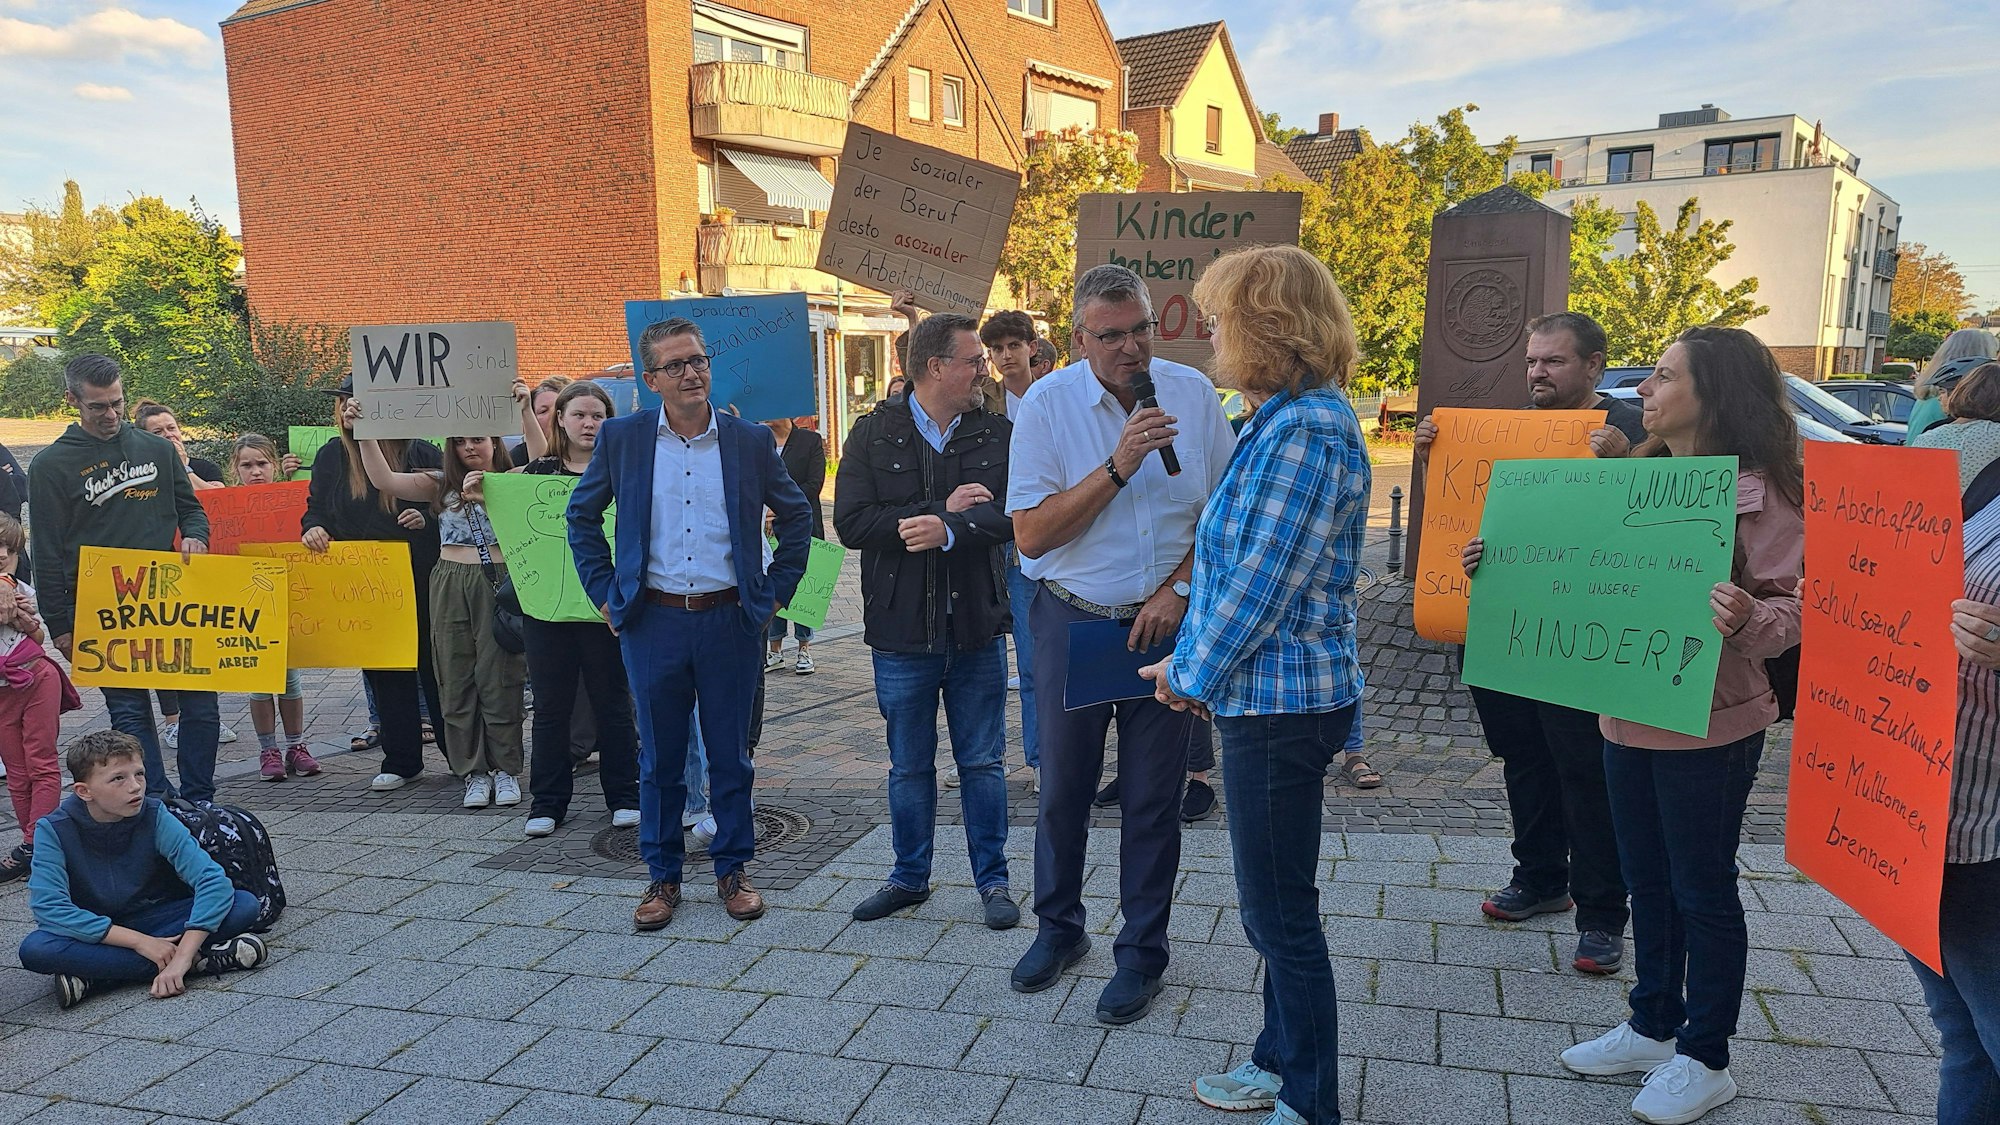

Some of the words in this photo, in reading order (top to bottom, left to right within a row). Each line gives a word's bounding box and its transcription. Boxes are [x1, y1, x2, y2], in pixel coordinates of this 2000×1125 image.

[856, 131, 882, 161] Je
[910, 157, 984, 191] sozialer
[854, 175, 881, 200] der
[900, 187, 966, 225] Beruf
[1116, 200, 1256, 240] Kinder
[838, 208, 880, 239] desto
[894, 233, 969, 264] asozialer
[824, 243, 844, 269] die
[691, 301, 757, 319] brauchen
[363, 332, 451, 387] WIR
[466, 346, 511, 370] sind
[370, 400, 405, 421] die
[414, 395, 516, 424] ZUKUNFT
[1450, 416, 1530, 445] NICHT
[1495, 469, 1559, 488] SCHENKT
[1565, 471, 1591, 484] UNS
[1599, 470, 1627, 485] EIN
[1627, 468, 1733, 511] WUNDER
[1427, 512, 1473, 534] KANN
[1834, 486, 1953, 565] Abschaffung
[515, 554, 528, 570] ist
[1483, 545, 1518, 566] UND
[1523, 544, 1580, 566] DENKT
[1590, 549, 1658, 571] ENDLICH
[1667, 555, 1705, 573] MAL
[1552, 580, 1572, 596] AN
[1588, 581, 1641, 598] UNSERE
[97, 602, 260, 633] BRAUCHEN
[78, 638, 211, 674] SCHUL
[1854, 705, 1866, 724] in
